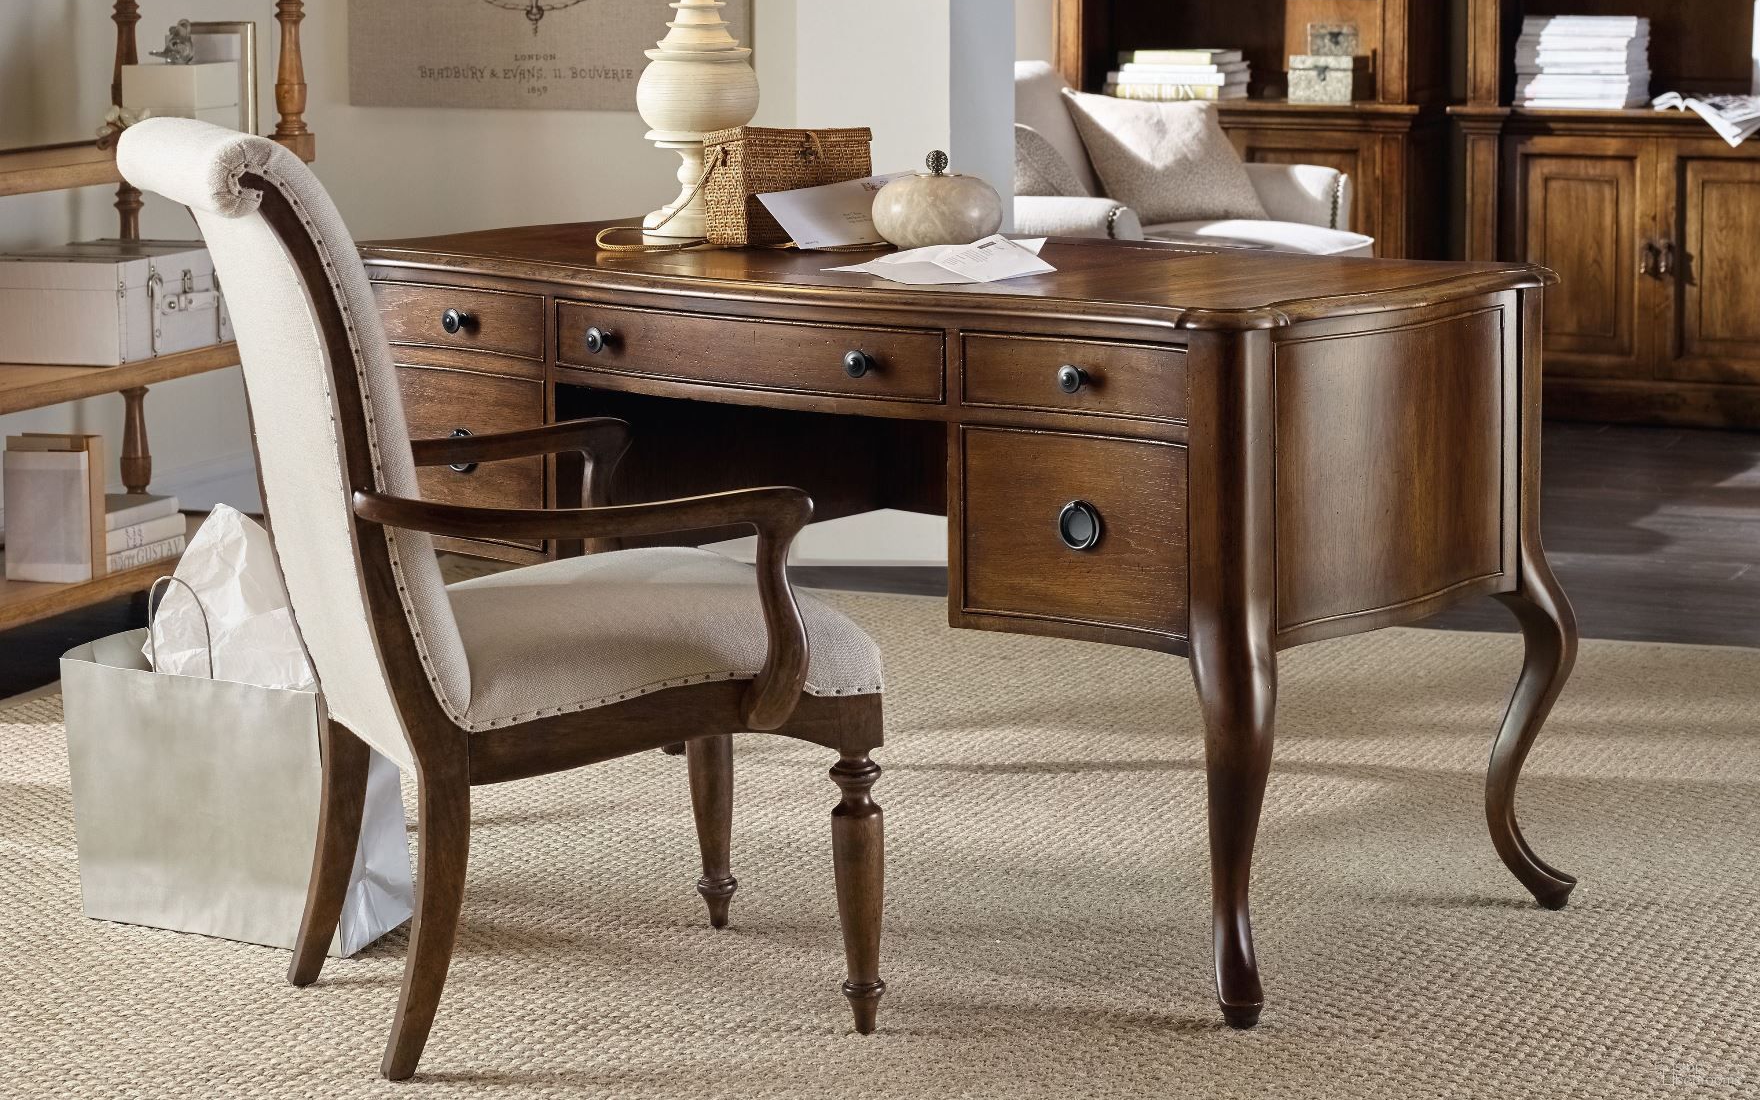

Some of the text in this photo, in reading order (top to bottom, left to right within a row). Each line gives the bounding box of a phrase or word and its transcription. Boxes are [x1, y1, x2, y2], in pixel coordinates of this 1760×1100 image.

[514, 53, 557, 62] LONDON
[417, 64, 487, 83] BRADBURY
[489, 68, 500, 79] &
[569, 65, 634, 81] BOUVERIE
[136, 538, 182, 565] GUSTAV
